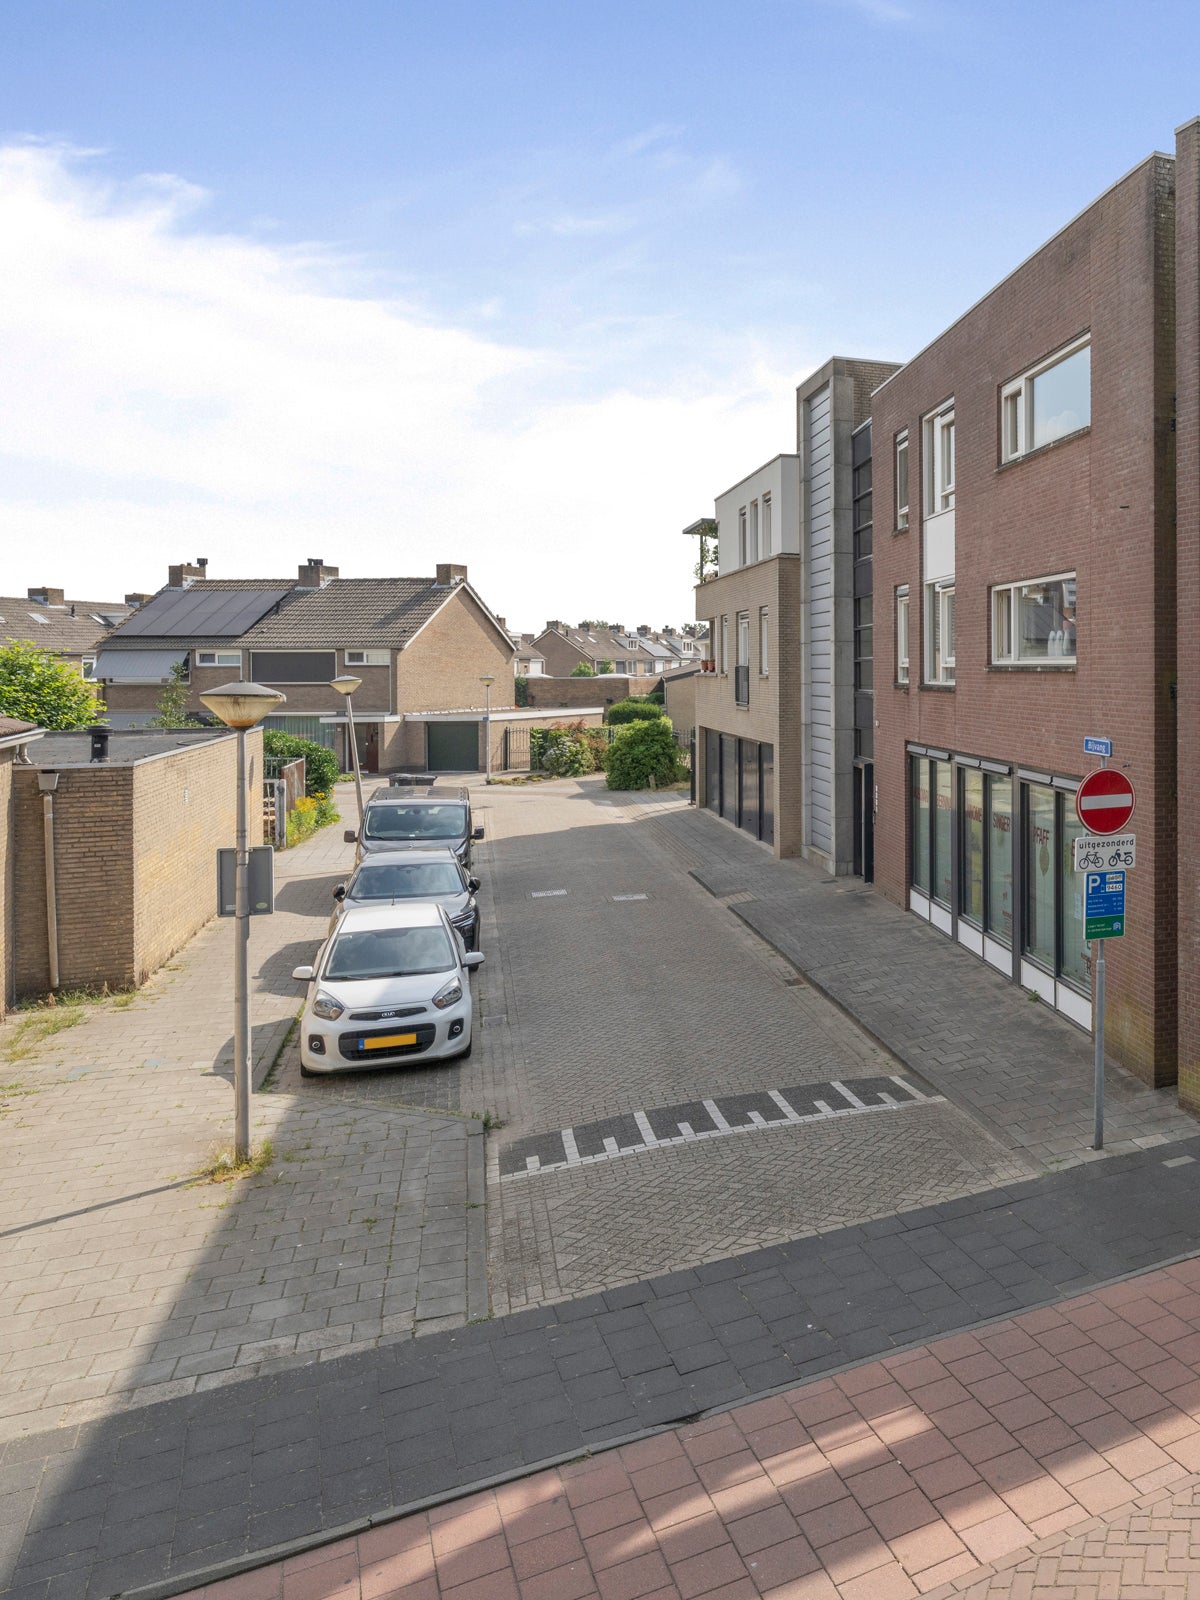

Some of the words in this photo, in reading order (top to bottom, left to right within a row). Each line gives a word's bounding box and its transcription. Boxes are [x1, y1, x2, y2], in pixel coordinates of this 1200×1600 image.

[1088, 741, 1106, 754] Bijvang
[1079, 839, 1134, 850] uitgezonderd
[1088, 875, 1101, 894] P
